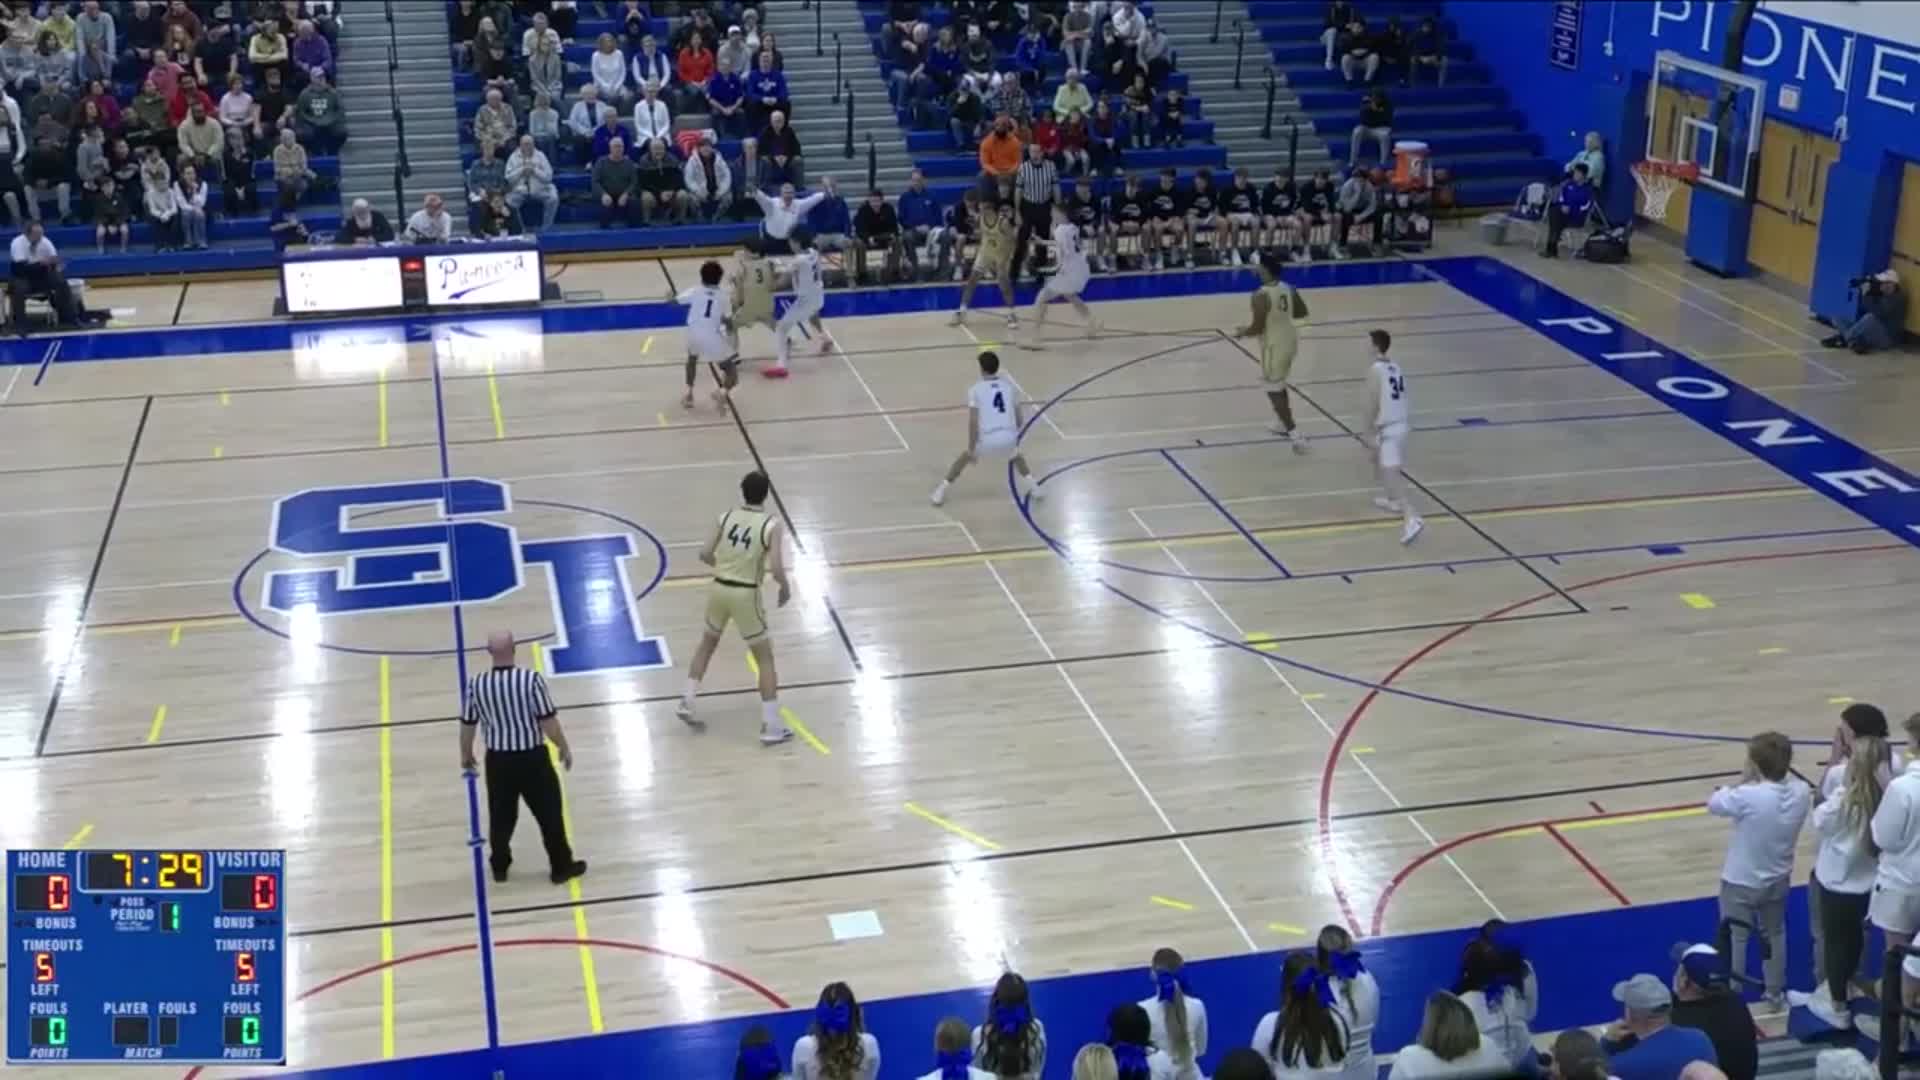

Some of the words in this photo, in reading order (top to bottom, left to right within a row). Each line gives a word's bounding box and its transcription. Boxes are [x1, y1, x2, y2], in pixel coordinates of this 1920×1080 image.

[704, 299, 713, 318] 1
[993, 391, 1005, 413] 4
[1538, 315, 1920, 534] PIONE
[728, 523, 752, 550] 44
